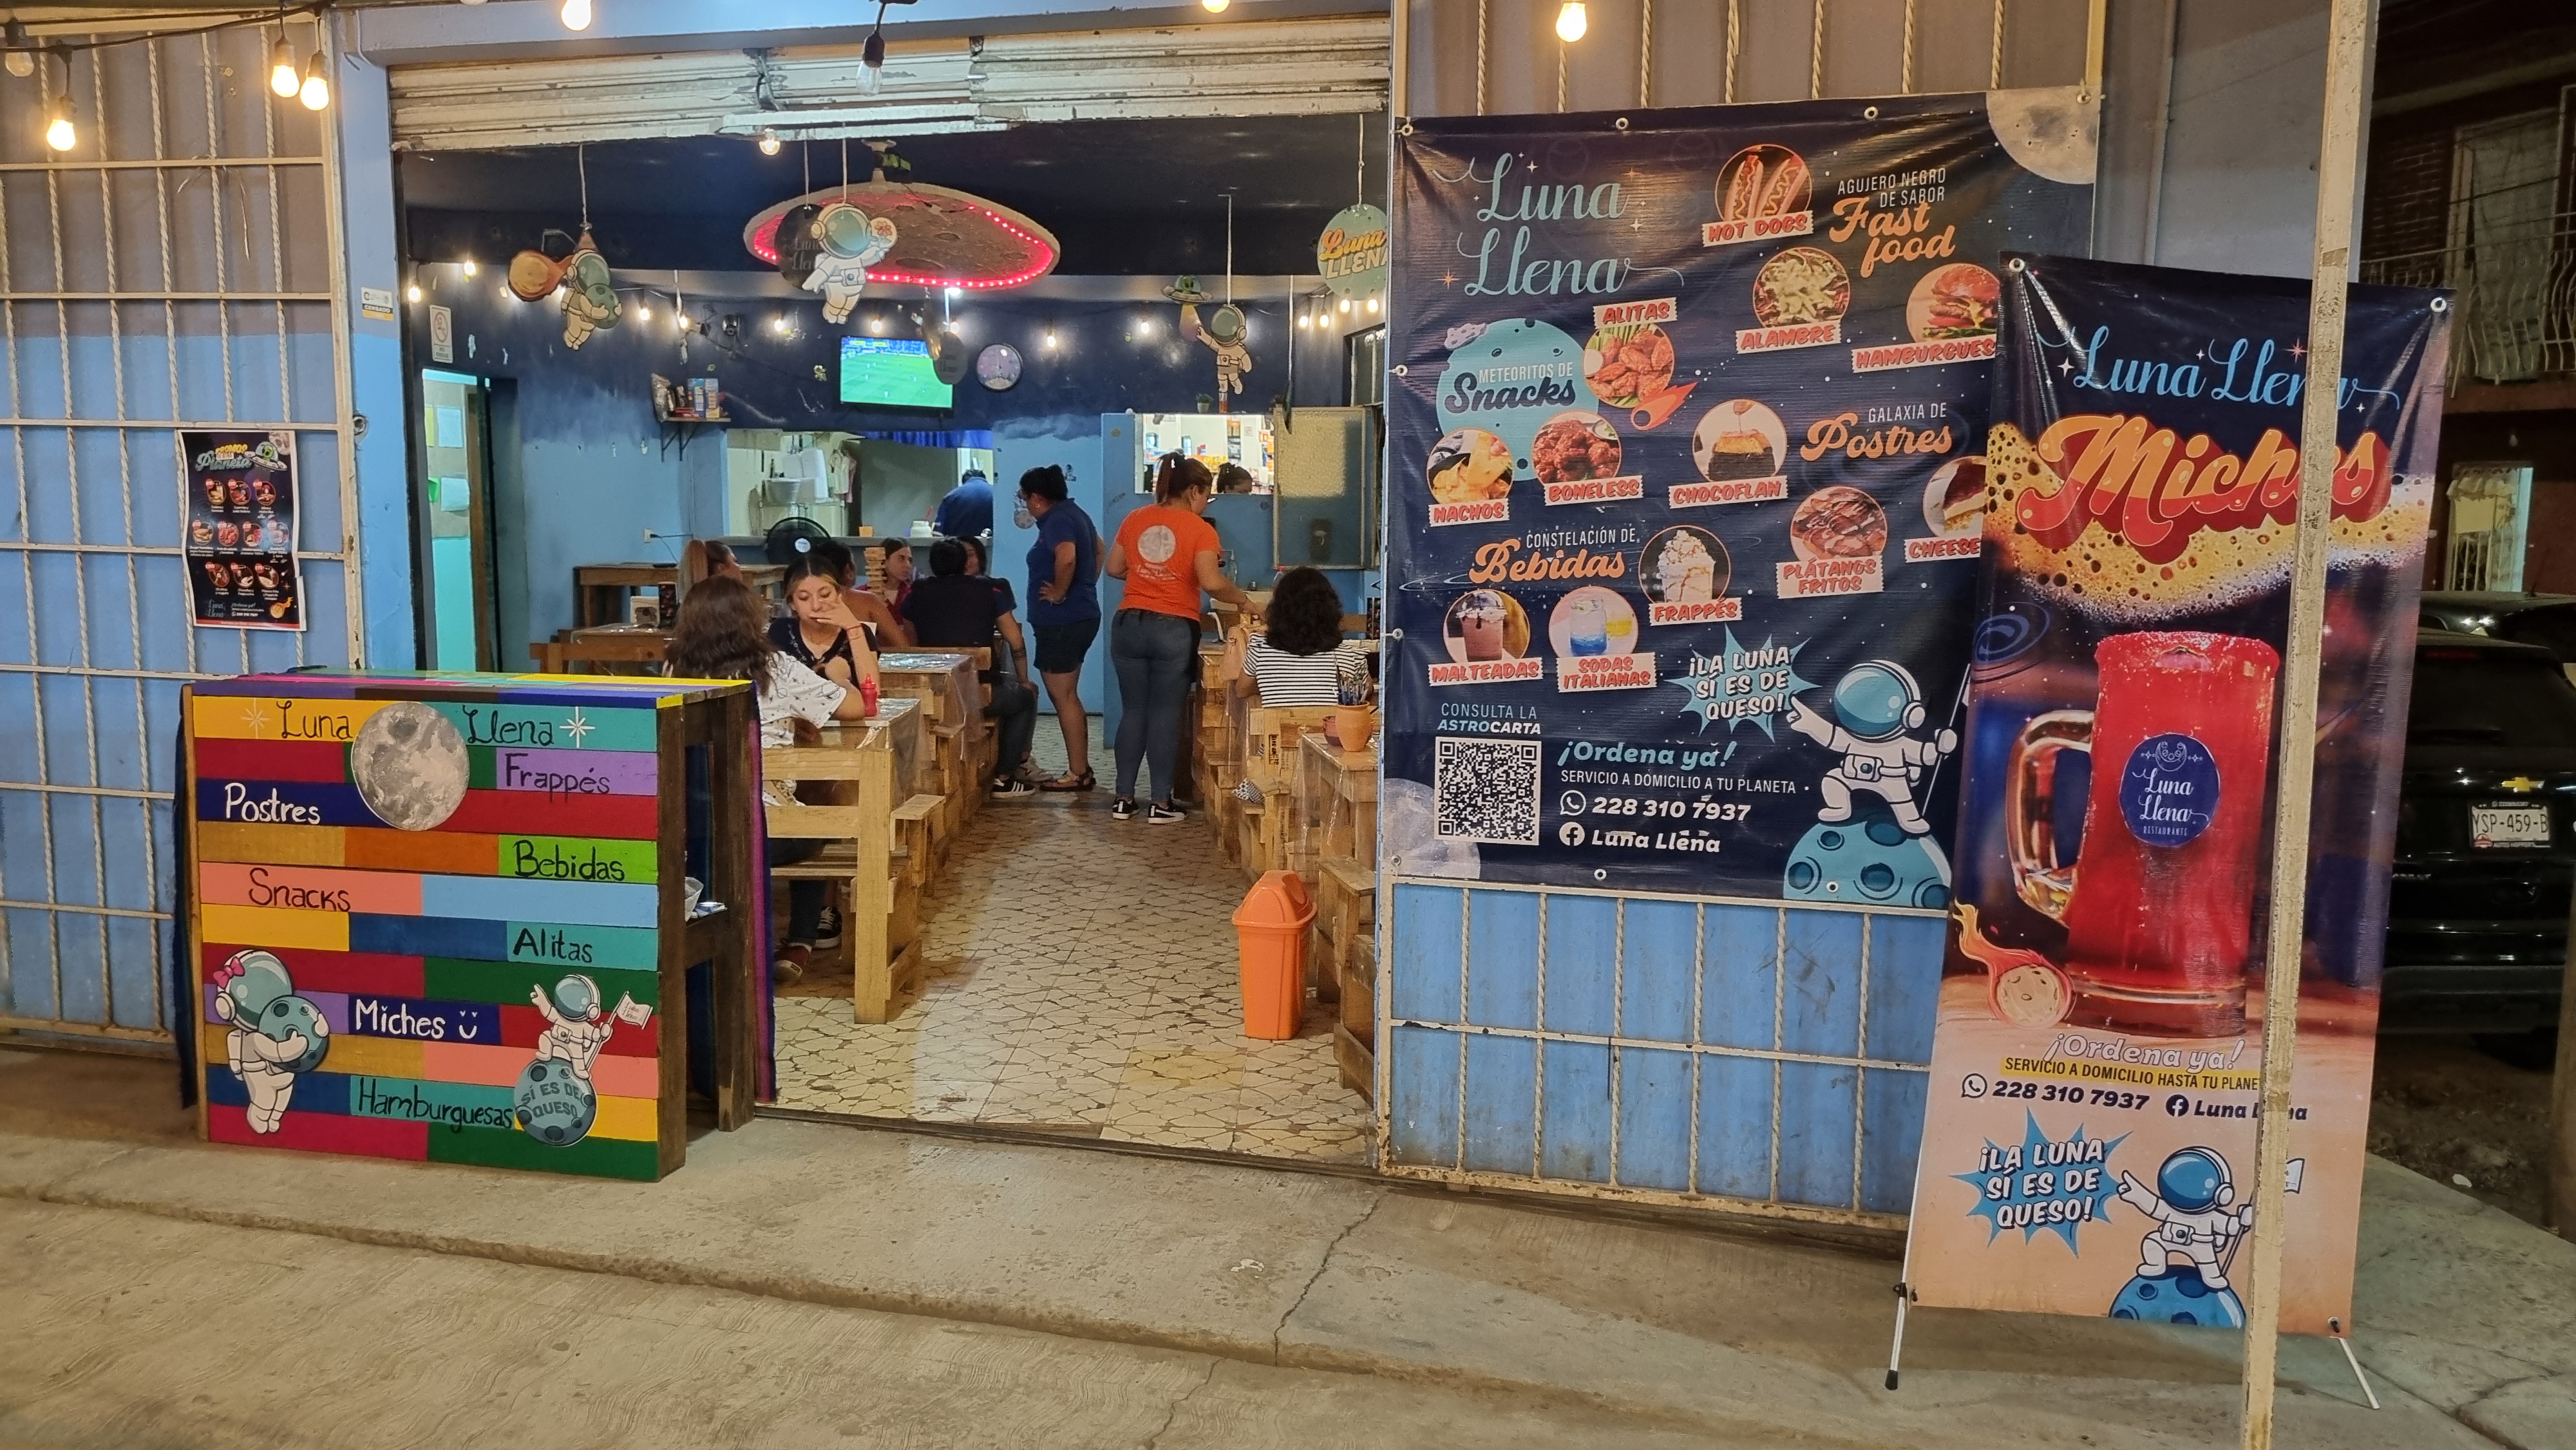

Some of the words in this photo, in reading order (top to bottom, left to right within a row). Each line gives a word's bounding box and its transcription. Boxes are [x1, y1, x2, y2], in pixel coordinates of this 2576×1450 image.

[1432, 153, 1630, 221] Luna
[1837, 177, 1896, 195] AGUJERO
[1901, 167, 1946, 186] NEGRO
[1880, 193, 1897, 207] DE
[1900, 187, 1944, 205] SABOR
[1709, 223, 1745, 241] HOT
[1754, 213, 1808, 236] DOGS
[1829, 196, 1930, 242] Fast
[1319, 229, 1387, 260] Luna
[1860, 225, 1955, 278] food
[1457, 226, 1684, 296] Llena
[1602, 301, 1670, 323] ALITAS
[1740, 324, 1835, 350] ALAMBRE
[1855, 341, 1996, 368] HAMBURGUES
[2036, 326, 2204, 397] Luna
[1479, 365, 1554, 384] METEORITOS
[1558, 362, 1573, 377] DE
[1444, 372, 1576, 413] Snacks
[1868, 405, 1924, 423] GALAXIA
[1930, 402, 1947, 418] DE
[1800, 412, 1953, 461] Postres
[1548, 480, 1639, 501] BONELESS
[1673, 480, 1781, 504] CHOCOFLAN
[2017, 415, 2386, 559] Michs
[1434, 502, 1504, 522] NACHOS
[1526, 527, 1616, 548] CONSTELACIÓN
[1621, 528, 1636, 543] DE
[1469, 539, 1625, 583] Bebidas
[1783, 558, 1877, 579] PLÁTANOS
[1798, 578, 1862, 594] FRITOS
[1654, 601, 1738, 621] FRAPPÉS
[1432, 662, 1539, 681] MALTEADAS
[1578, 657, 1633, 672] SODAS
[1689, 654, 1723, 677] ¡LA
[1732, 646, 1790, 670] LUNA
[1563, 671, 1651, 689] ITALIANAS
[1696, 676, 1717, 699] SÍ
[1725, 674, 1750, 693] ES
[1759, 669, 1788, 690] DE
[276, 701, 354, 740] Luna
[1441, 702, 1515, 719] CONSULTA
[1519, 704, 1537, 719] LA
[1705, 693, 1783, 720] QUESO!
[462, 705, 554, 746] Llena
[1437, 719, 1541, 735] ASTROCARTA
[1558, 740, 1674, 767] ¡Ordena
[1680, 740, 1737, 771] ya!
[504, 753, 611, 802] Frappés
[1561, 769, 1617, 785] SERVICIO
[1622, 773, 1630, 786] A
[1634, 773, 1700, 789] DOMICILIO
[1705, 777, 1713, 789] A
[1716, 777, 1733, 791] TU
[1738, 778, 1795, 794] PLANETA
[2132, 767, 2194, 795] Luna
[225, 782, 321, 825] Postres
[1592, 796, 1637, 816] 228
[1643, 798, 1685, 818] 310
[1692, 801, 1750, 821] 7937
[2138, 795, 2208, 822] Llena
[2473, 813, 2547, 833] YSP-459-B
[1592, 829, 1649, 849] Luna
[1655, 831, 1720, 852] Llena
[513, 840, 625, 882] Bebidas
[249, 867, 351, 912] Snacks
[515, 928, 594, 964] Alitas
[355, 1000, 444, 1039] Miches
[2045, 1034, 2180, 1067] ¡Ordena
[2188, 1039, 2245, 1073] ya!
[2005, 1057, 2065, 1075] SERVICIO
[2070, 1062, 2079, 1075] A
[2082, 1064, 2154, 1084] DOMICILIO
[2158, 1073, 2197, 1088] HASTA
[2201, 1075, 2217, 1089] TU
[2222, 1077, 2259, 1091] PLANE
[358, 1077, 513, 1133] Hamburguesas
[521, 1086, 536, 1106] SÍ
[540, 1082, 560, 1096] ES
[564, 1082, 580, 1100] DE
[1992, 1080, 2038, 1099] 228
[2042, 1085, 2084, 1103] 310
[2090, 1089, 2150, 1109] 7937
[2194, 1100, 2247, 1119] Luna
[533, 1102, 578, 1118] QUESO
[1979, 1146, 2022, 1172] ¡LA
[2033, 1139, 2103, 1166] LUNA
[1987, 1170, 2011, 1199] SÍ
[2022, 1172, 2056, 1196] ES
[2065, 1169, 2099, 1193] DE
[1997, 1198, 2094, 1229] QUESO!
